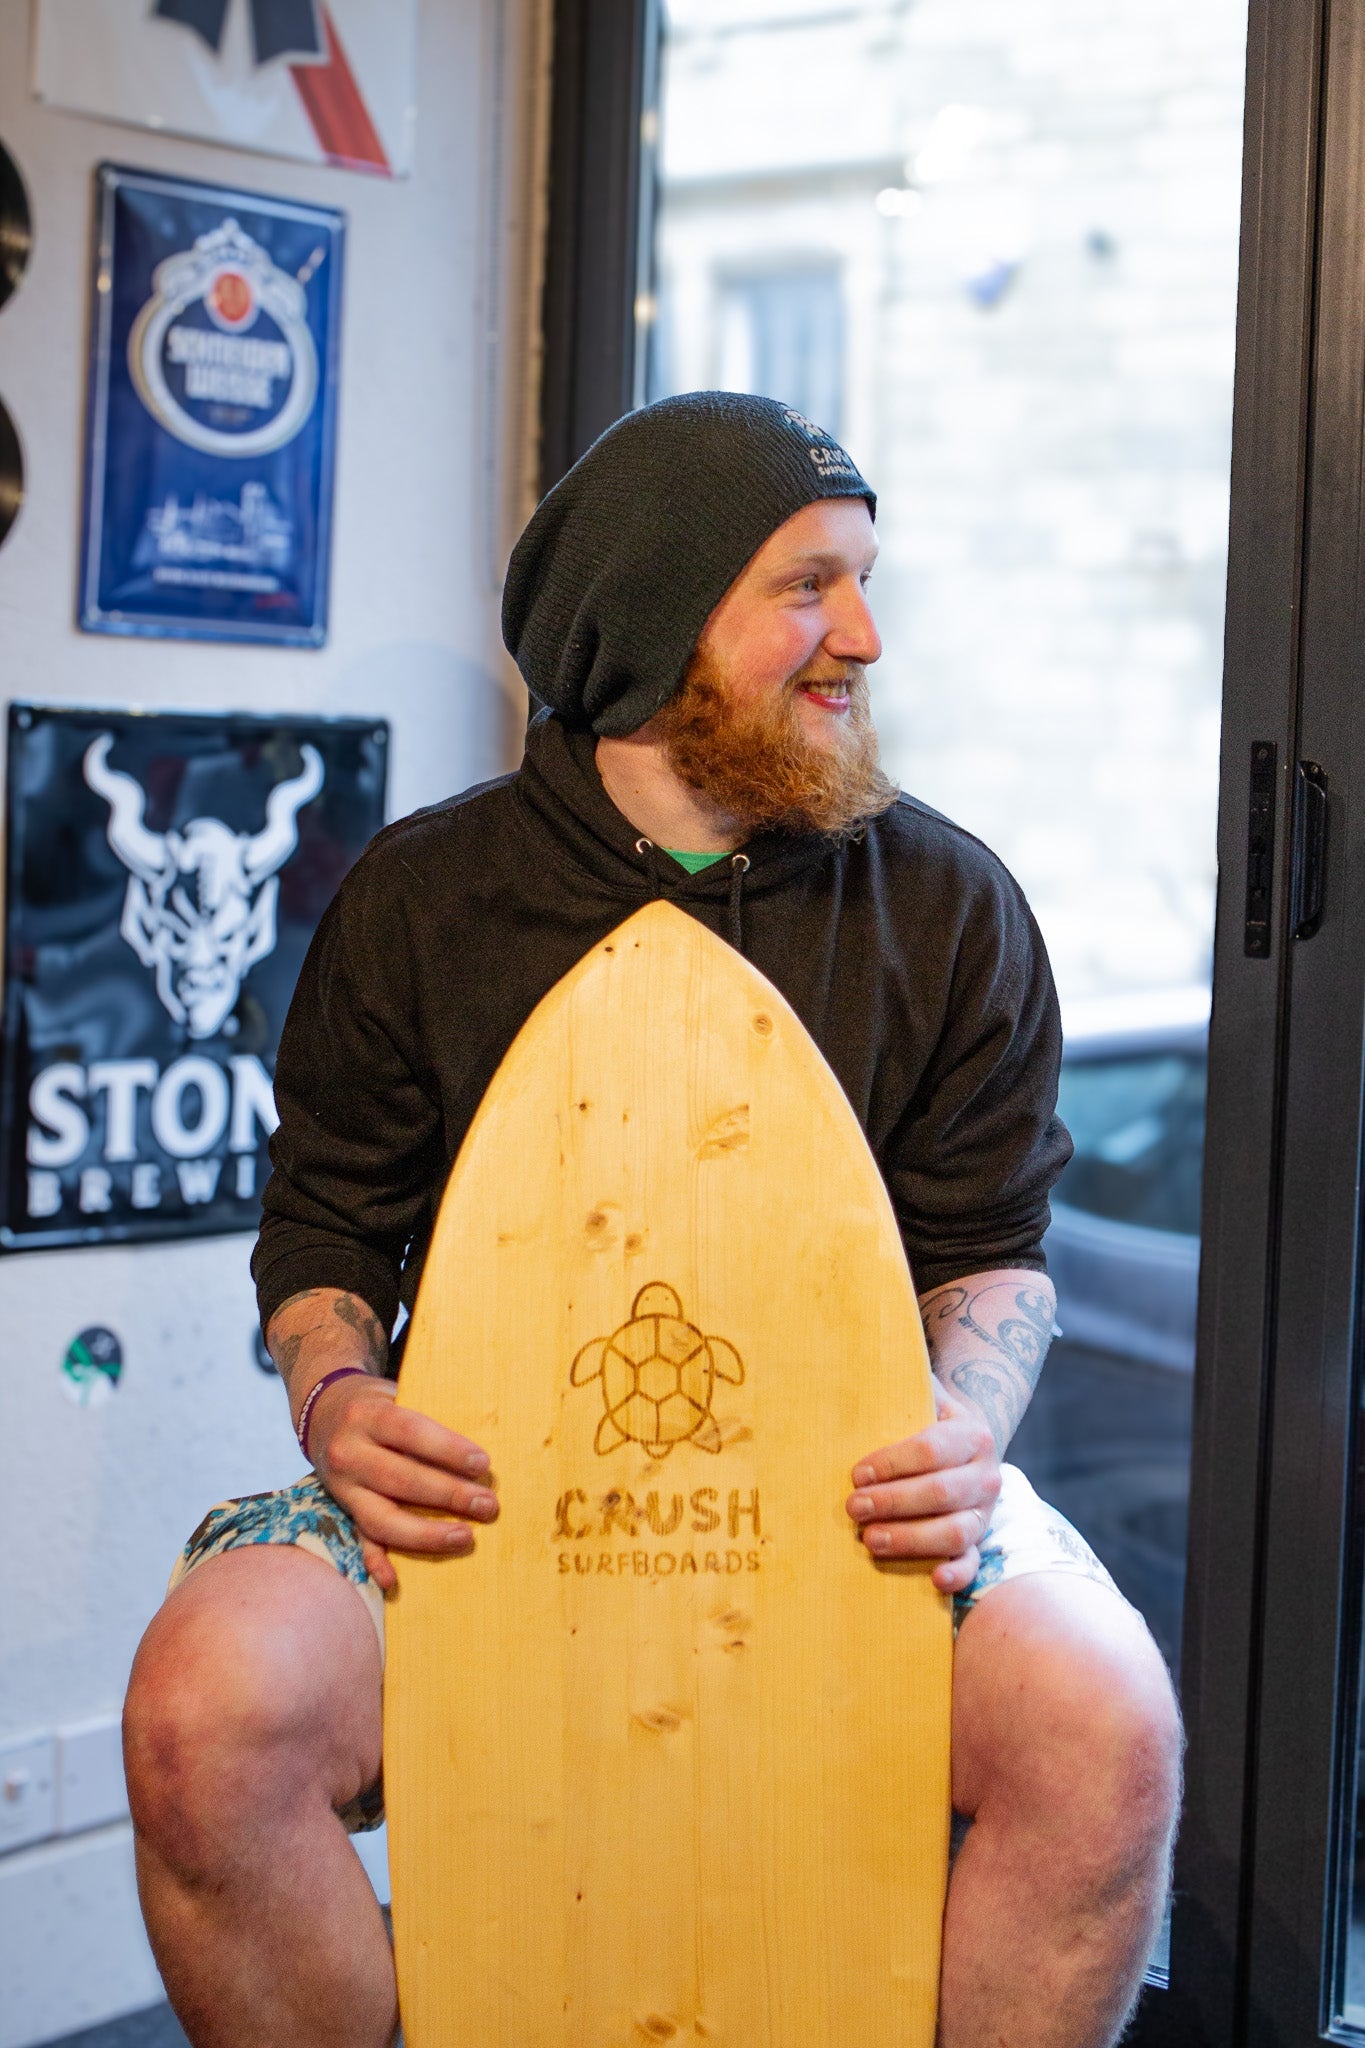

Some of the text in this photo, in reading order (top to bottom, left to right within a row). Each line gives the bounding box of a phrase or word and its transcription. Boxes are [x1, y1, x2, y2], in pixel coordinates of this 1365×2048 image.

[27, 1054, 280, 1168] STON
[27, 1154, 256, 1218] BREWI
[555, 1487, 762, 1539] CRUSH
[557, 1550, 761, 1576] SURFBOARDS
